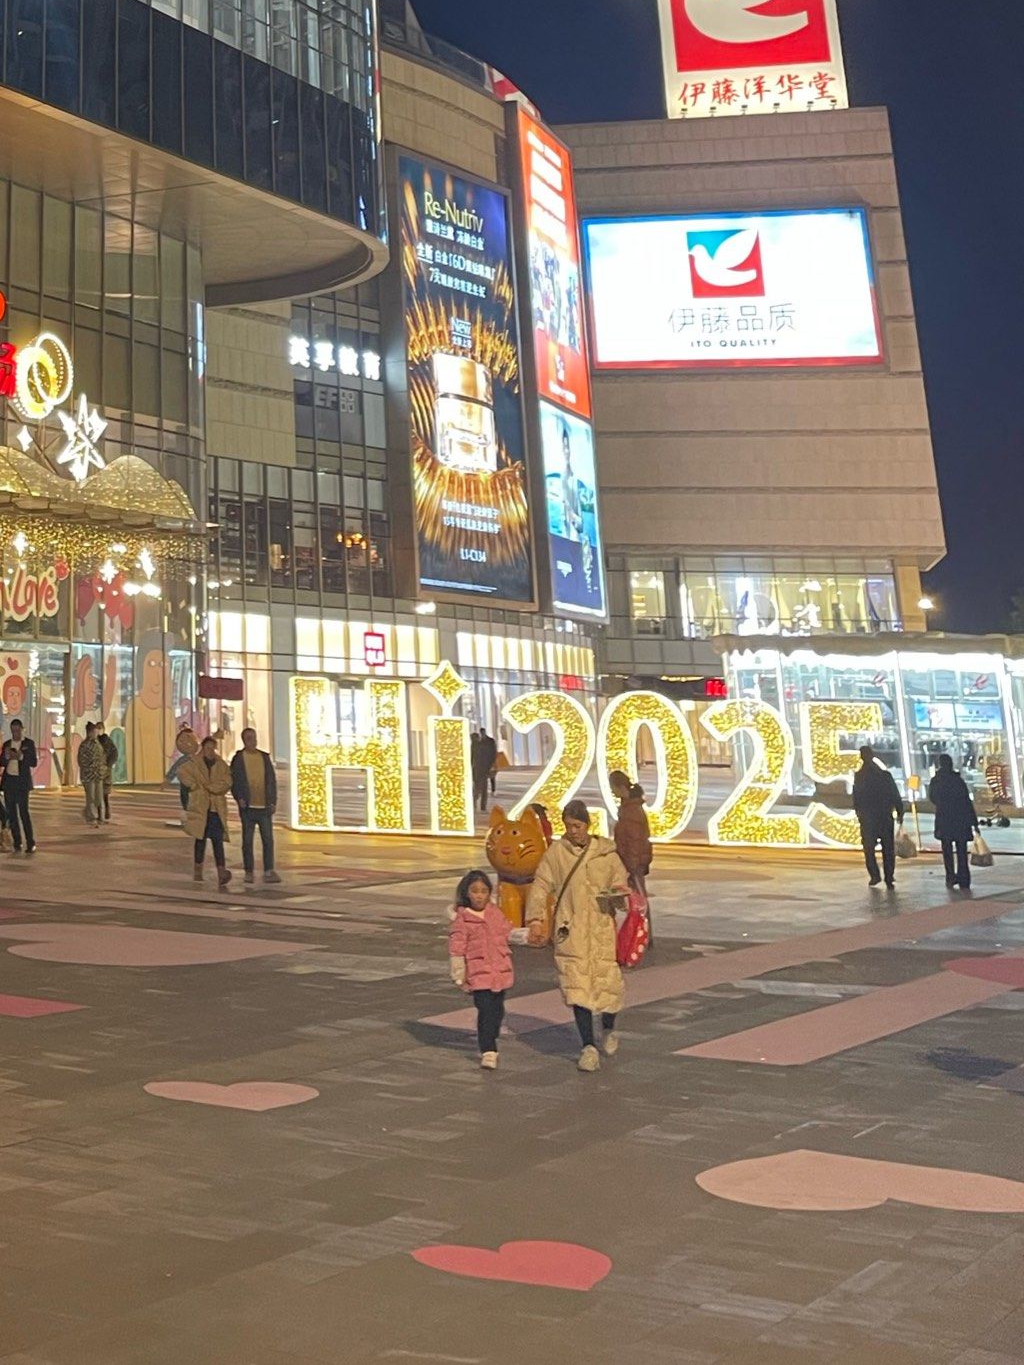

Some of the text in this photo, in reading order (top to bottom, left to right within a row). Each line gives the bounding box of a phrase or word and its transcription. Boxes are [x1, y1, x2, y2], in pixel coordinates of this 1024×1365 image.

[678, 72, 836, 106] 伊藤洋华堂
[424, 191, 483, 233] Re-Nutriv
[668, 303, 796, 333] 伊藤品质
[691, 339, 776, 347] ITO QUALITY
[12, 568, 57, 616] Love
[289, 659, 885, 848] Hi 2025
